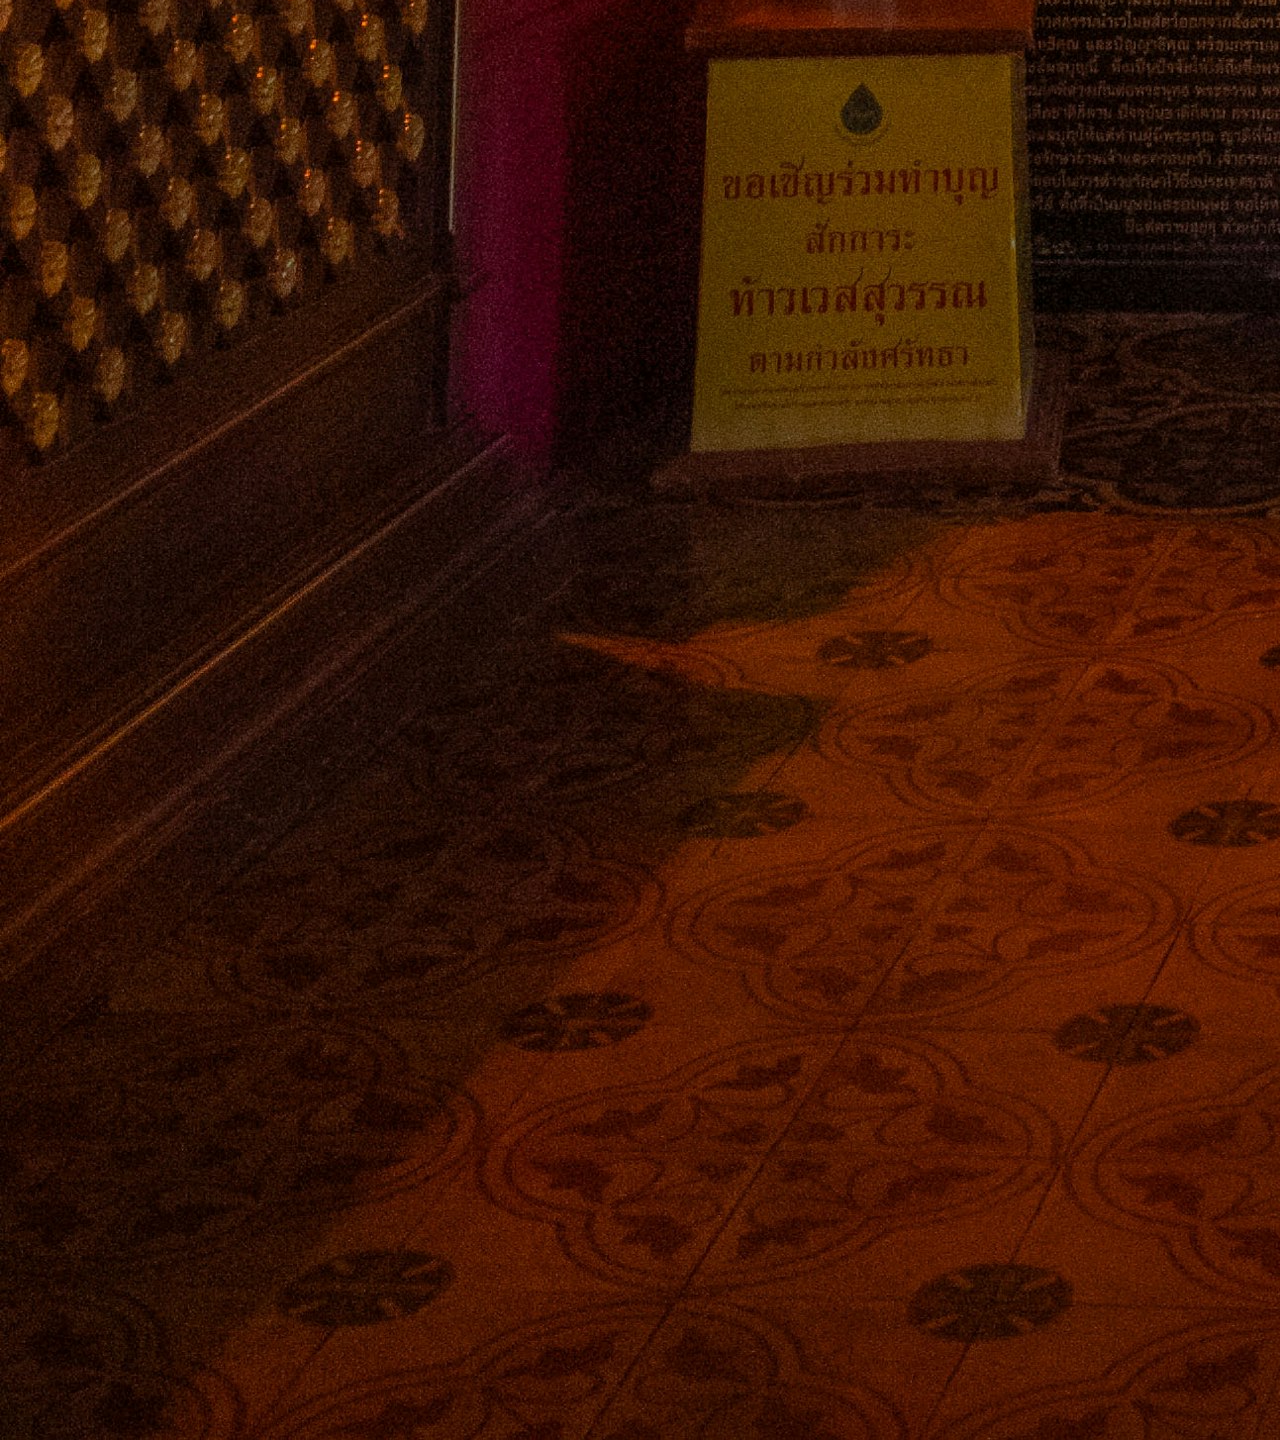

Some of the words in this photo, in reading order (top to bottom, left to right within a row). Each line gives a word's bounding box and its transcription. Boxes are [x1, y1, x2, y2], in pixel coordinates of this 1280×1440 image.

[721, 157, 1000, 209] ขอเชิญร่วมทำบุญ
[804, 221, 917, 256] สักการะ
[728, 266, 989, 327] ท้าวเวสสุวรรณ
[748, 334, 970, 376] ตามกำลังศรัทธา
